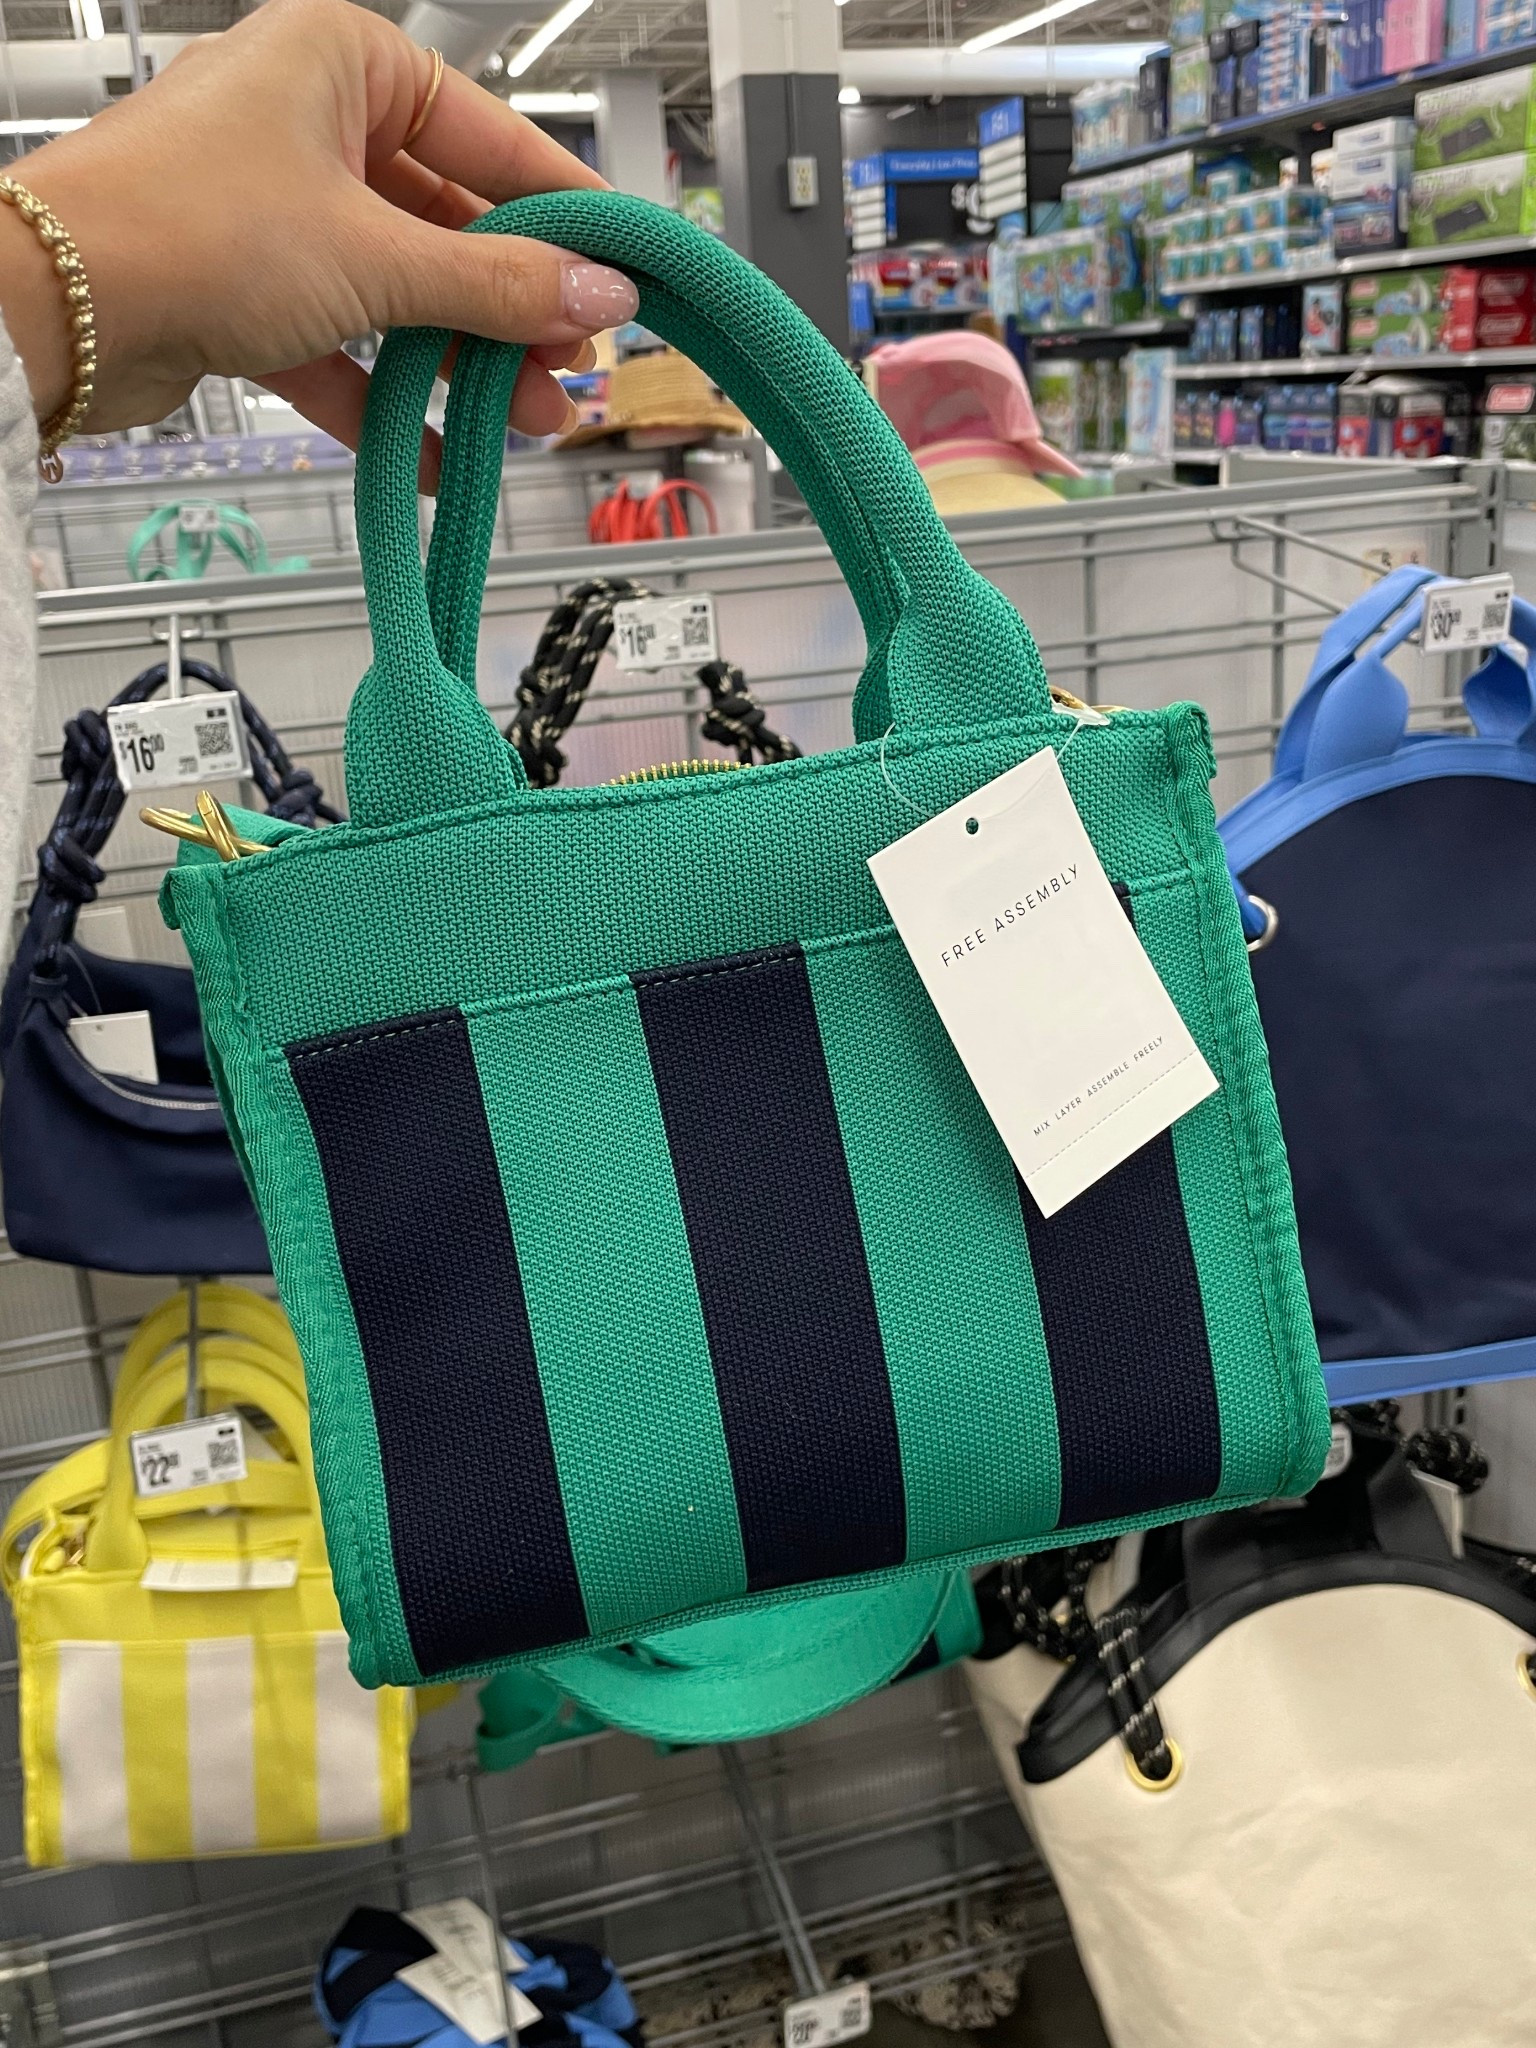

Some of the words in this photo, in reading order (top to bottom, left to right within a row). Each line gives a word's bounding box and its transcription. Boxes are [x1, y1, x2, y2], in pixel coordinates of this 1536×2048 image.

[941, 928, 986, 967] FREE
[994, 863, 1078, 932] ASSEMBLY
[1033, 1120, 1051, 1136] MIX
[1055, 1097, 1082, 1121] LAYER
[1087, 1061, 1129, 1097] ASSEMBLE
[1133, 1036, 1163, 1062] FREELY
